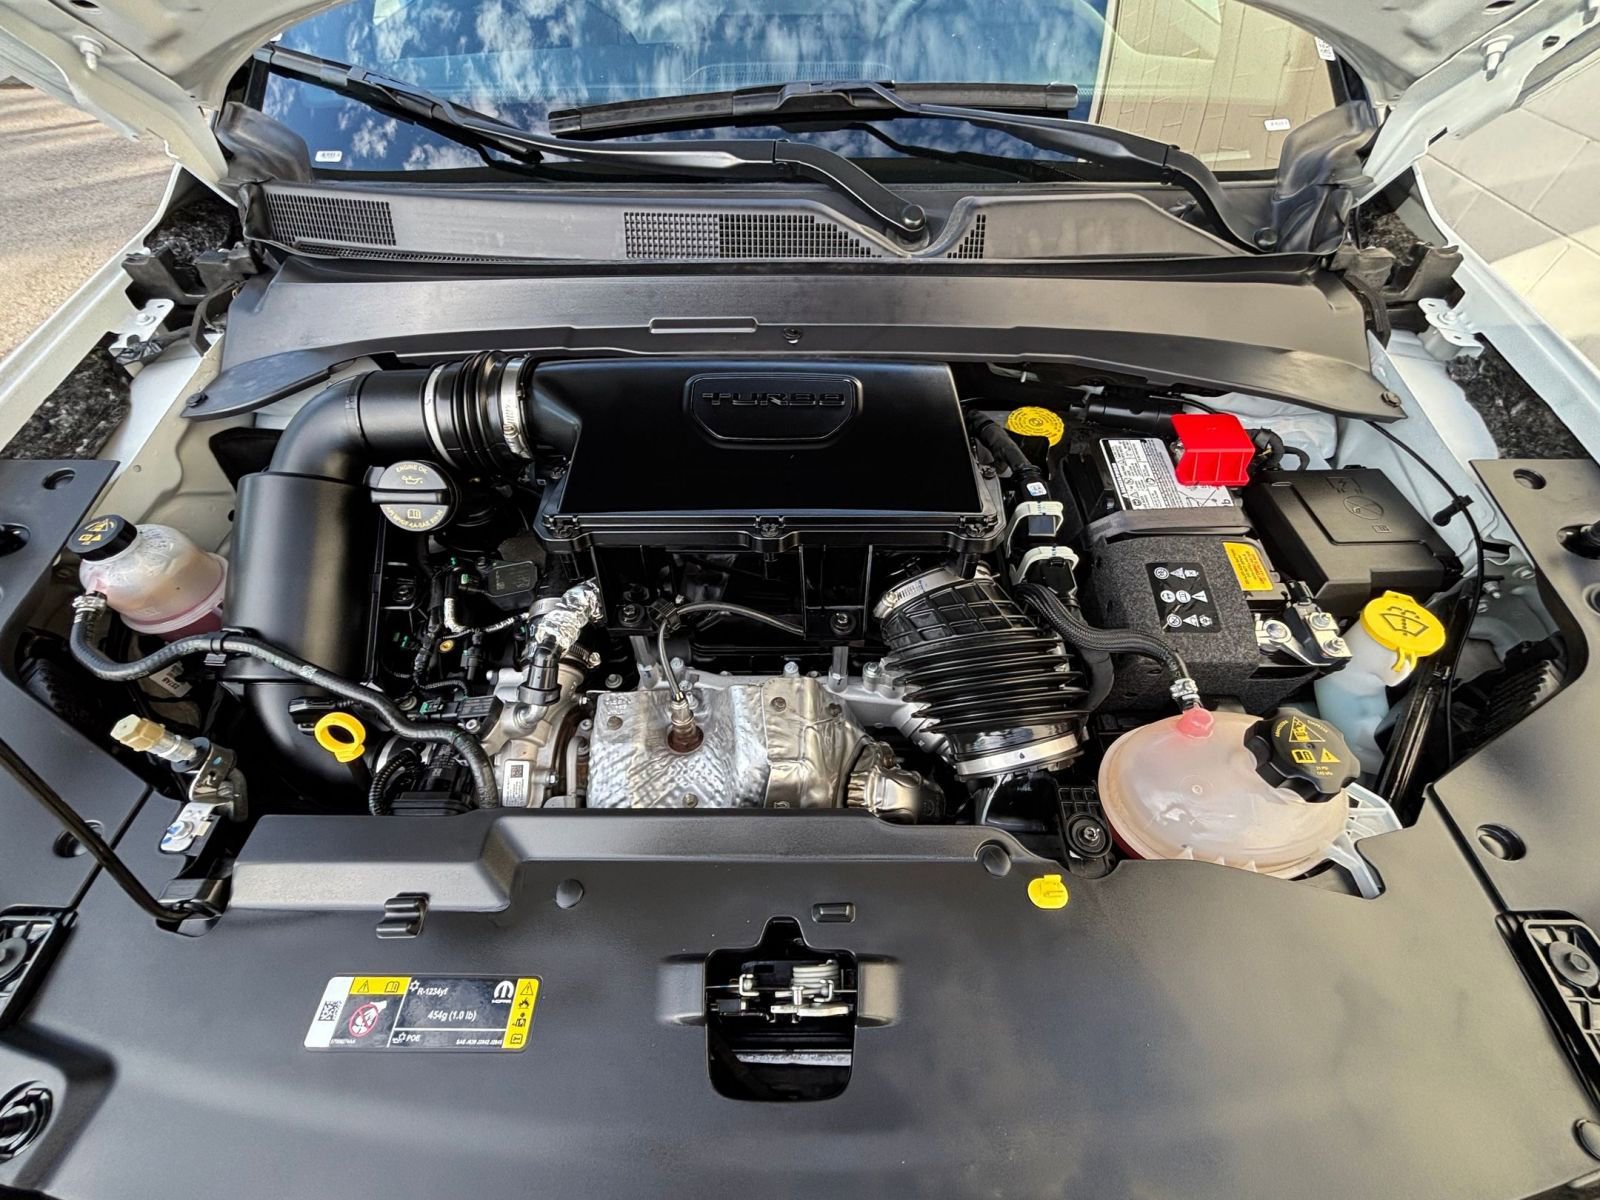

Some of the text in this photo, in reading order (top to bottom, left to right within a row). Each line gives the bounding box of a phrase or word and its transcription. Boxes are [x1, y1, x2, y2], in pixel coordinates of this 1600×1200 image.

[702, 392, 846, 406] TURBO
[396, 464, 418, 473] ENGINE
[417, 987, 449, 997] R-1234yf
[428, 1010, 477, 1021] 454g (1.0 lb)
